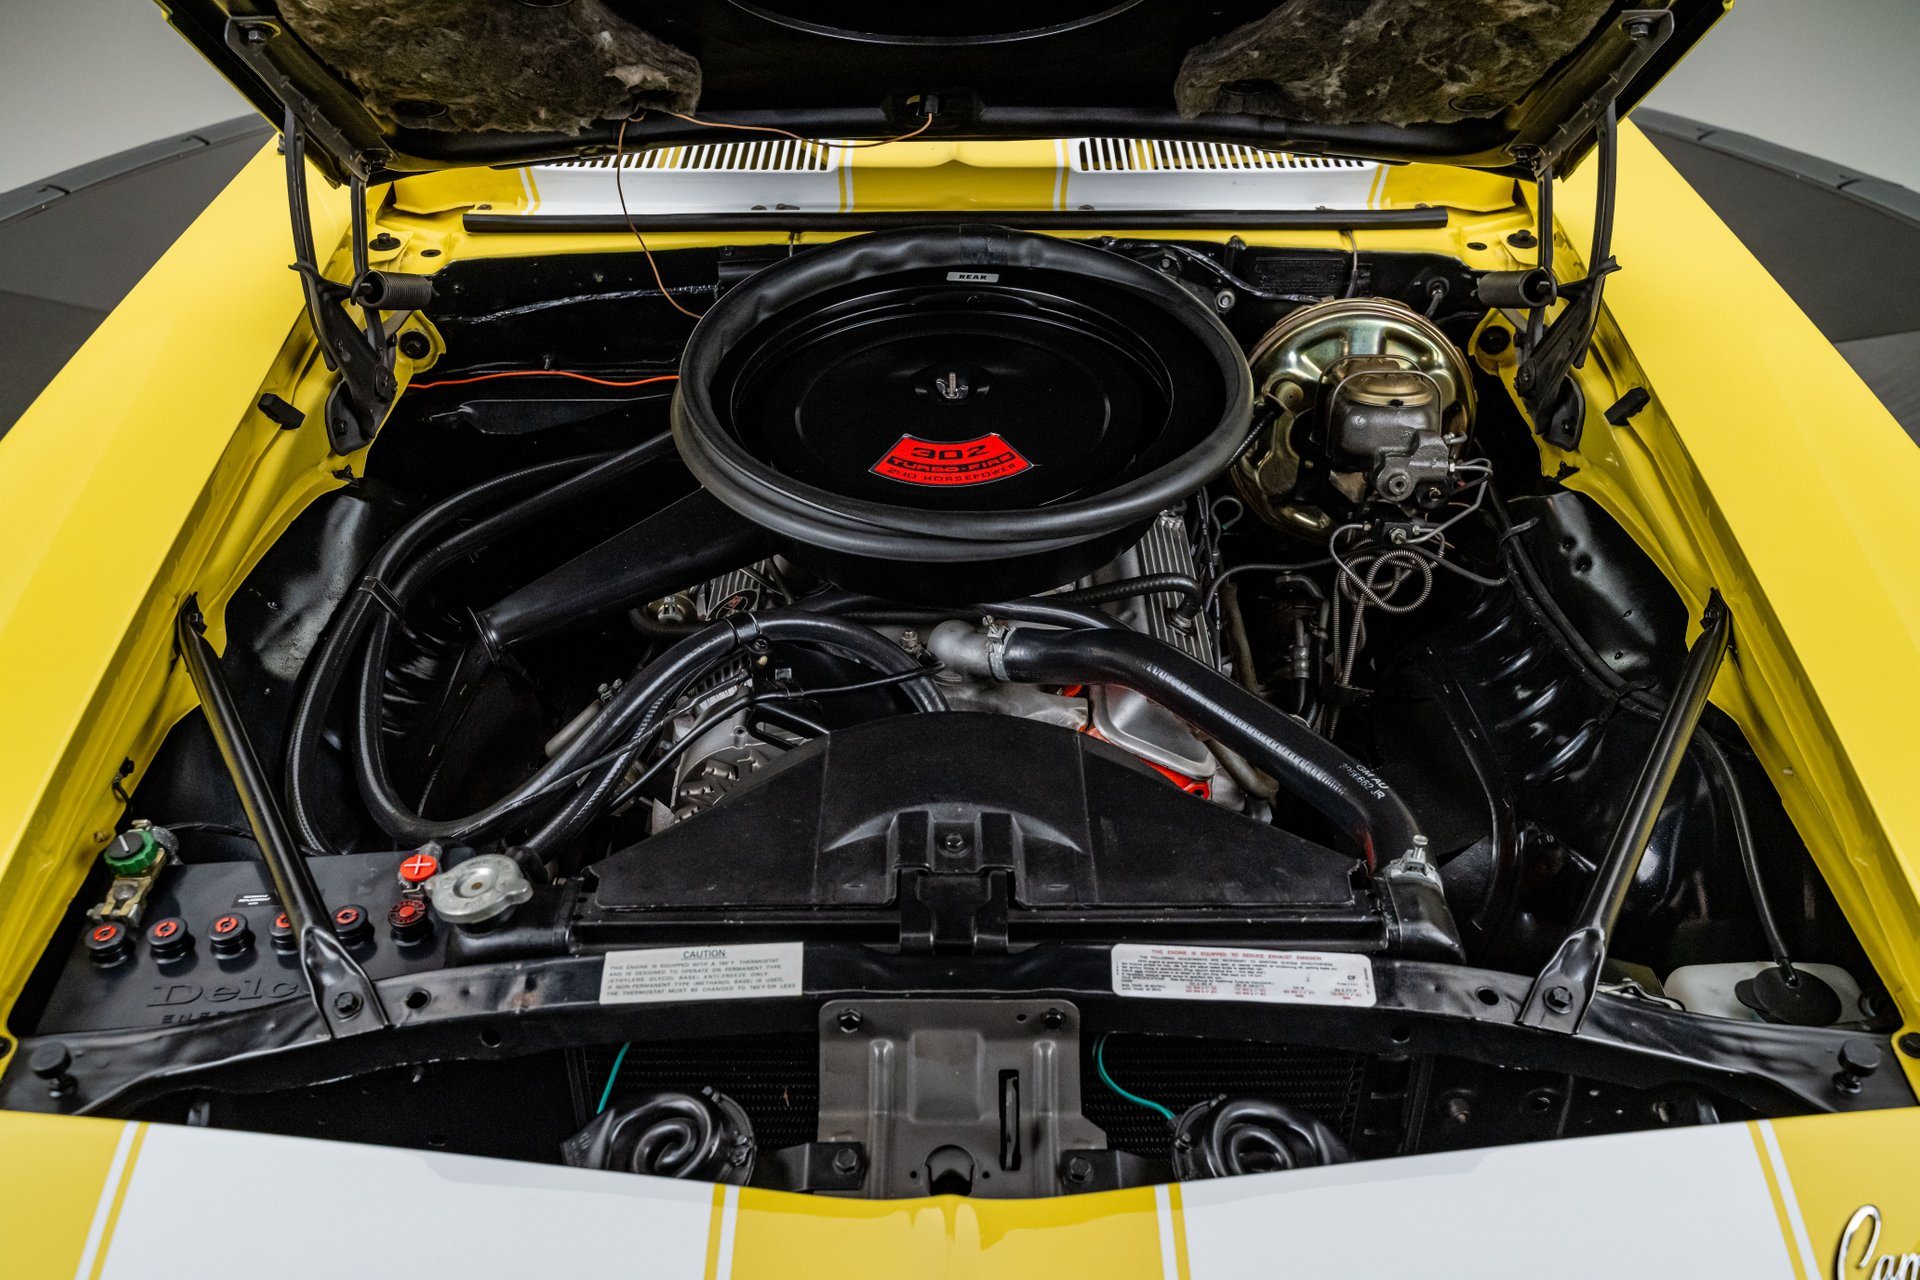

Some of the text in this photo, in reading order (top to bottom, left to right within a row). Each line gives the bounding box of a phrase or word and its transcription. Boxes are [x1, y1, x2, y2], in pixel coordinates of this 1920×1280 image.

[912, 444, 990, 461] 302
[888, 463, 1016, 481] 290 HORSEPOWER
[683, 949, 726, 960] CAUTION
[147, 978, 299, 1007] Delc
